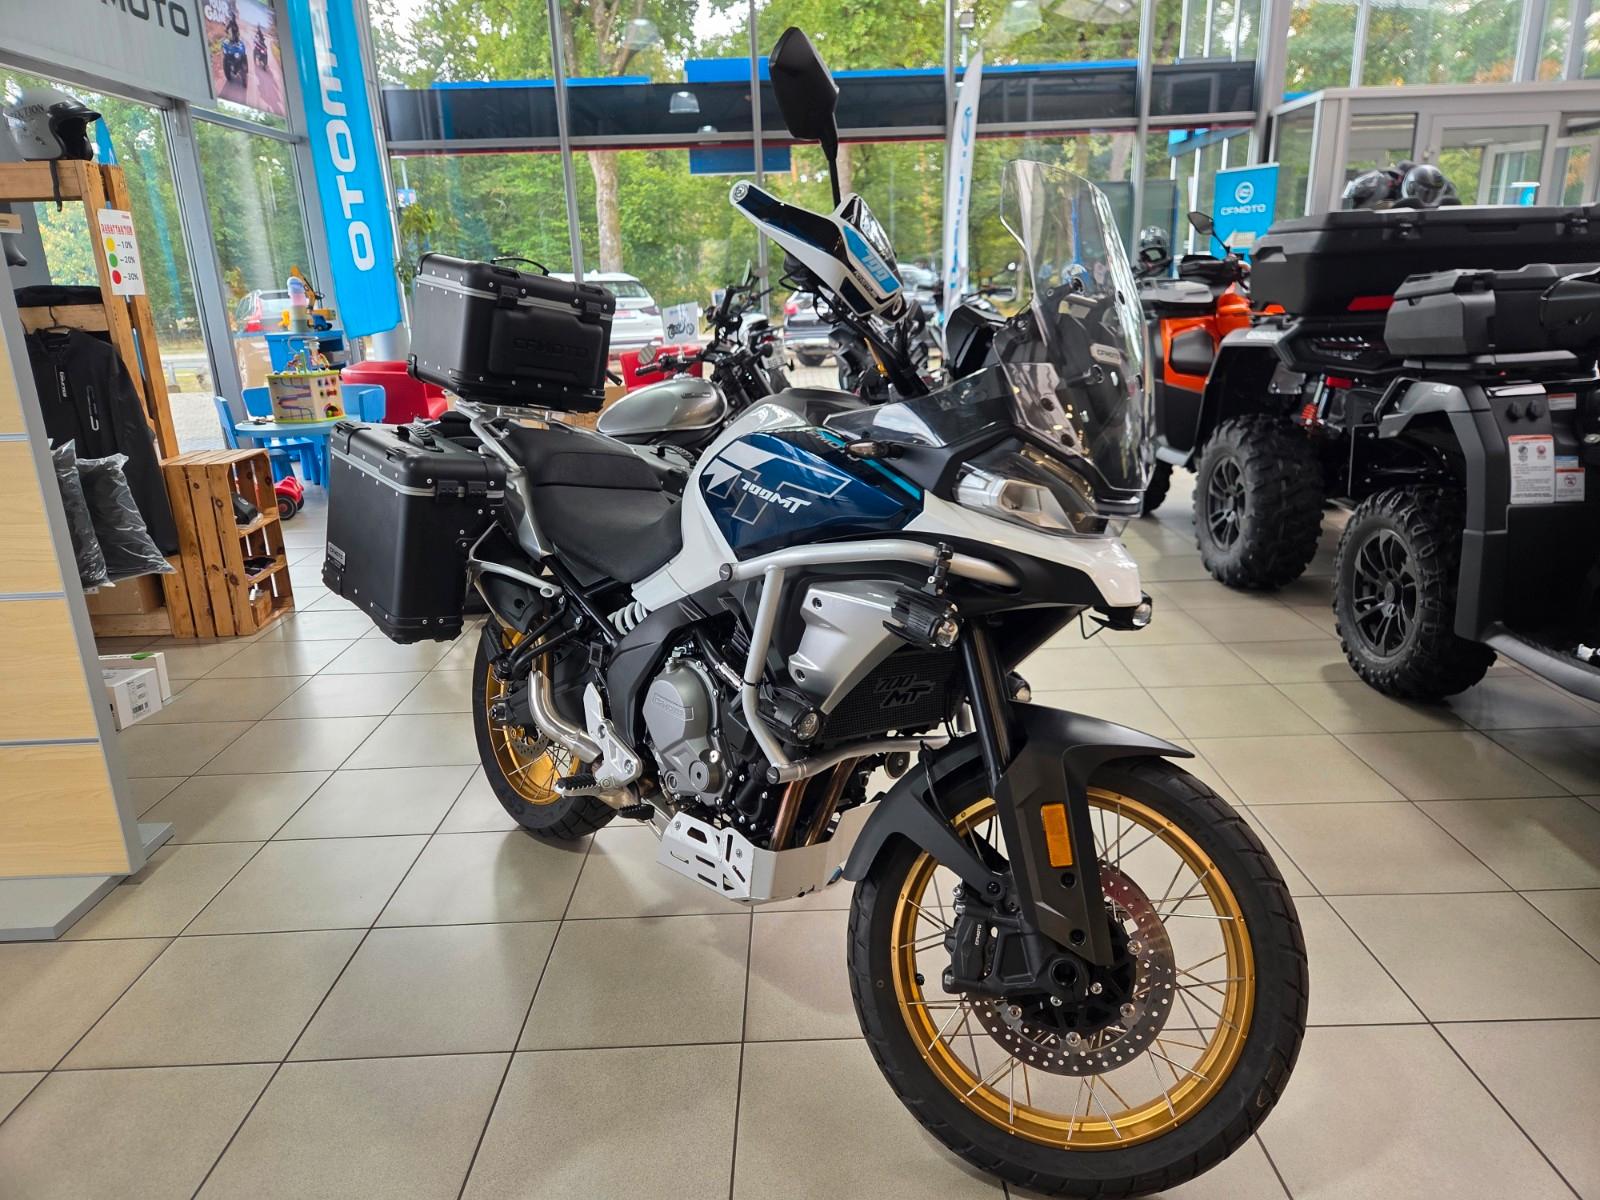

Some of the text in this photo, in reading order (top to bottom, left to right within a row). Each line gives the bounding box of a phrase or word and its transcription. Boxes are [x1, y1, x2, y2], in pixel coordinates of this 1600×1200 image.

[1220, 203, 1267, 216] CFMOTO
[874, 674, 917, 693] 700
[880, 683, 935, 708] MT
